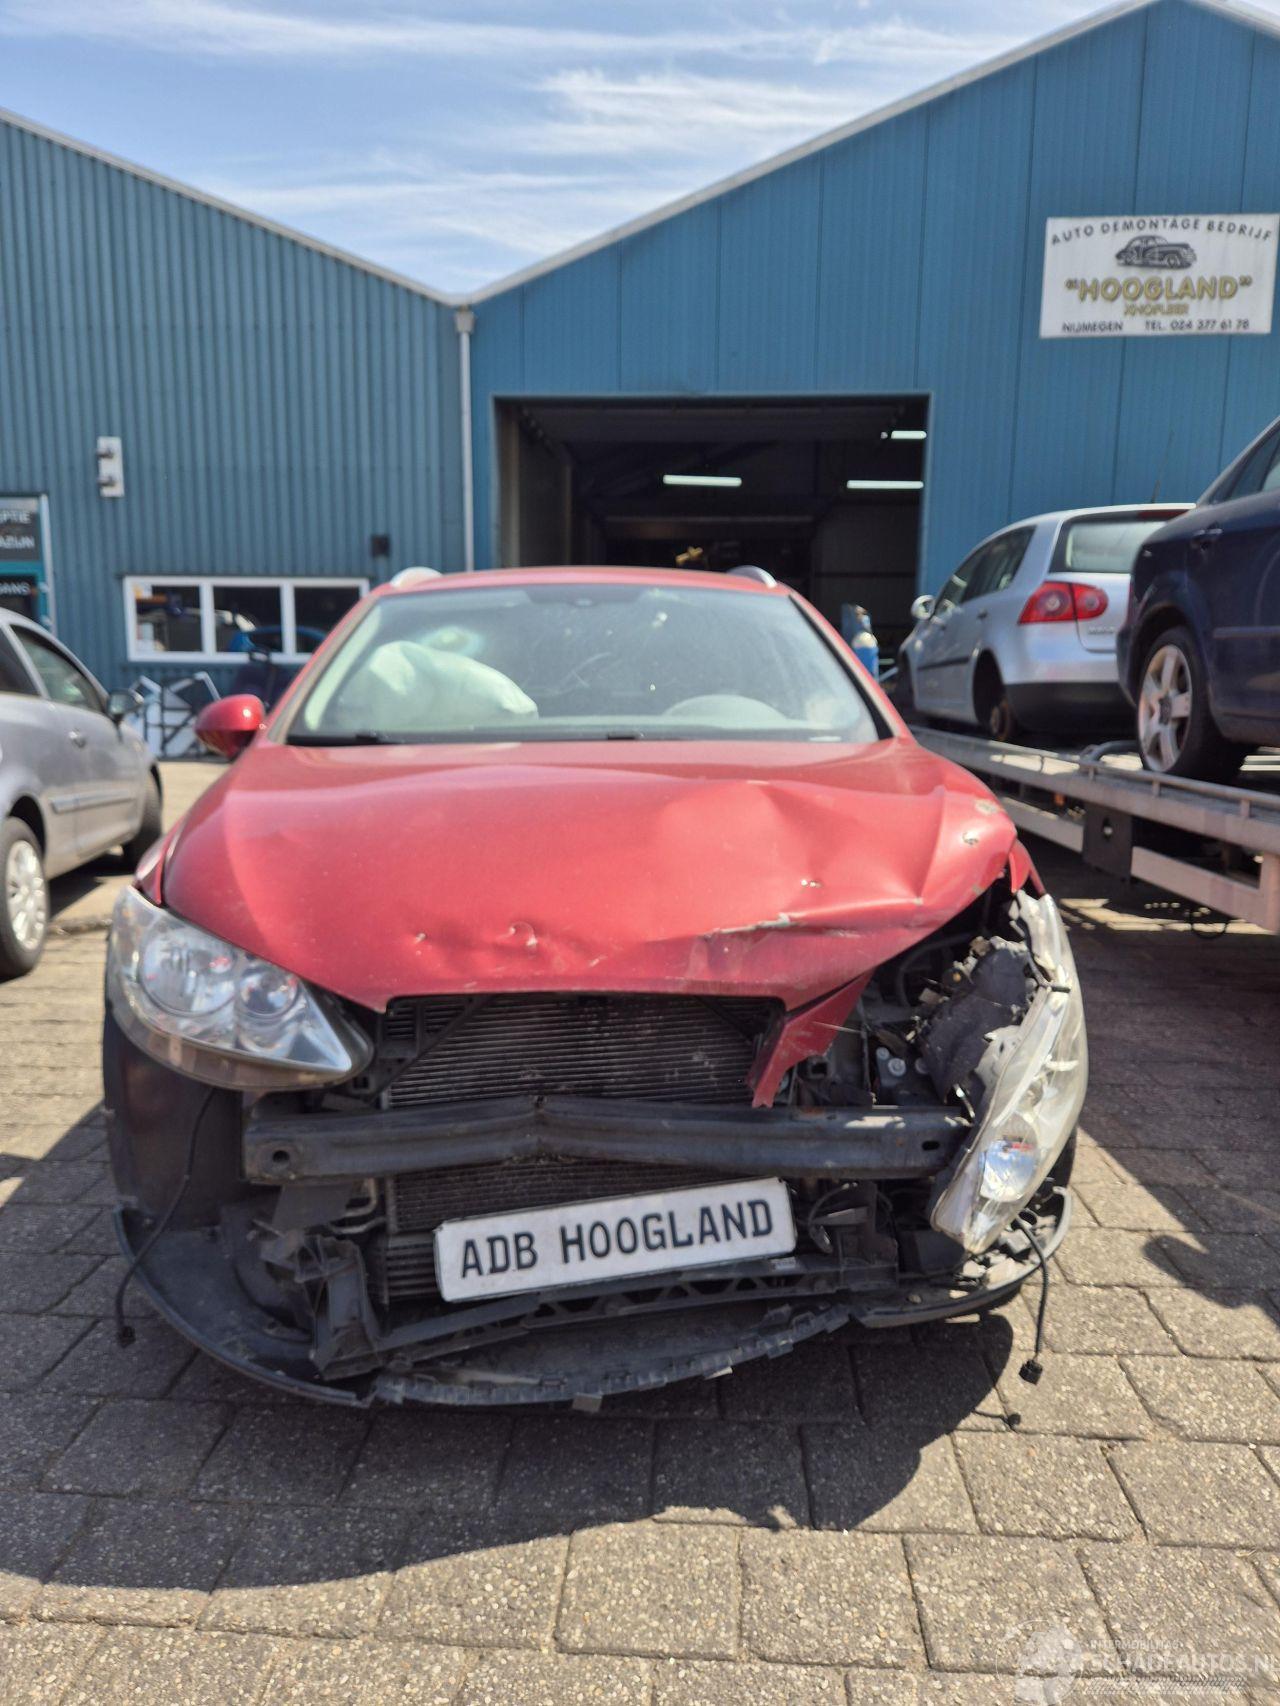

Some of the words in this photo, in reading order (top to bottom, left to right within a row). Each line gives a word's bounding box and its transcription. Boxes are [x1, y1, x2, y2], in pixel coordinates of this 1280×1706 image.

[1051, 225, 1095, 246] AUTO
[1101, 218, 1200, 235] DEMONTAGE
[1207, 221, 1273, 242] BEDRIJF
[1062, 320, 1123, 332] NIJMEGEN
[1170, 319, 1193, 331] 024
[1198, 319, 1217, 330] 377
[1221, 318, 1232, 330] 61
[1236, 318, 1250, 330] 78
[461, 1231, 538, 1279] ADB
[560, 1198, 774, 1264] HOOGLAND
